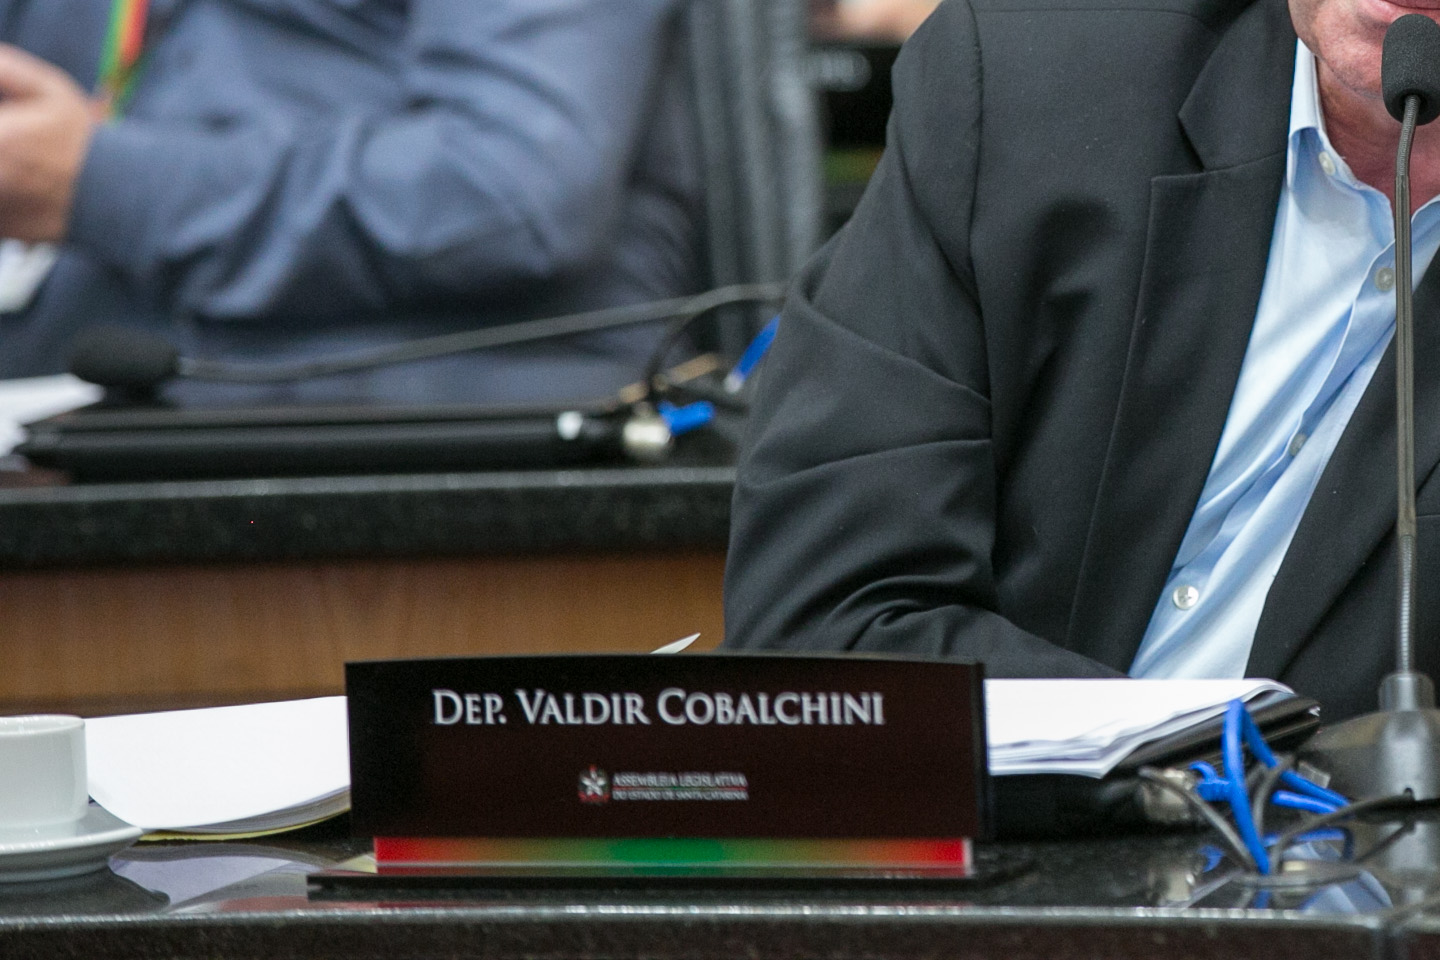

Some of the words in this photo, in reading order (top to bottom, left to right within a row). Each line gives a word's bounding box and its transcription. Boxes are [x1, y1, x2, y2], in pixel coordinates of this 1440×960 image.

[432, 688, 507, 725] DEP.
[515, 688, 651, 725] VALDIR
[656, 686, 885, 726] COBALCHINI
